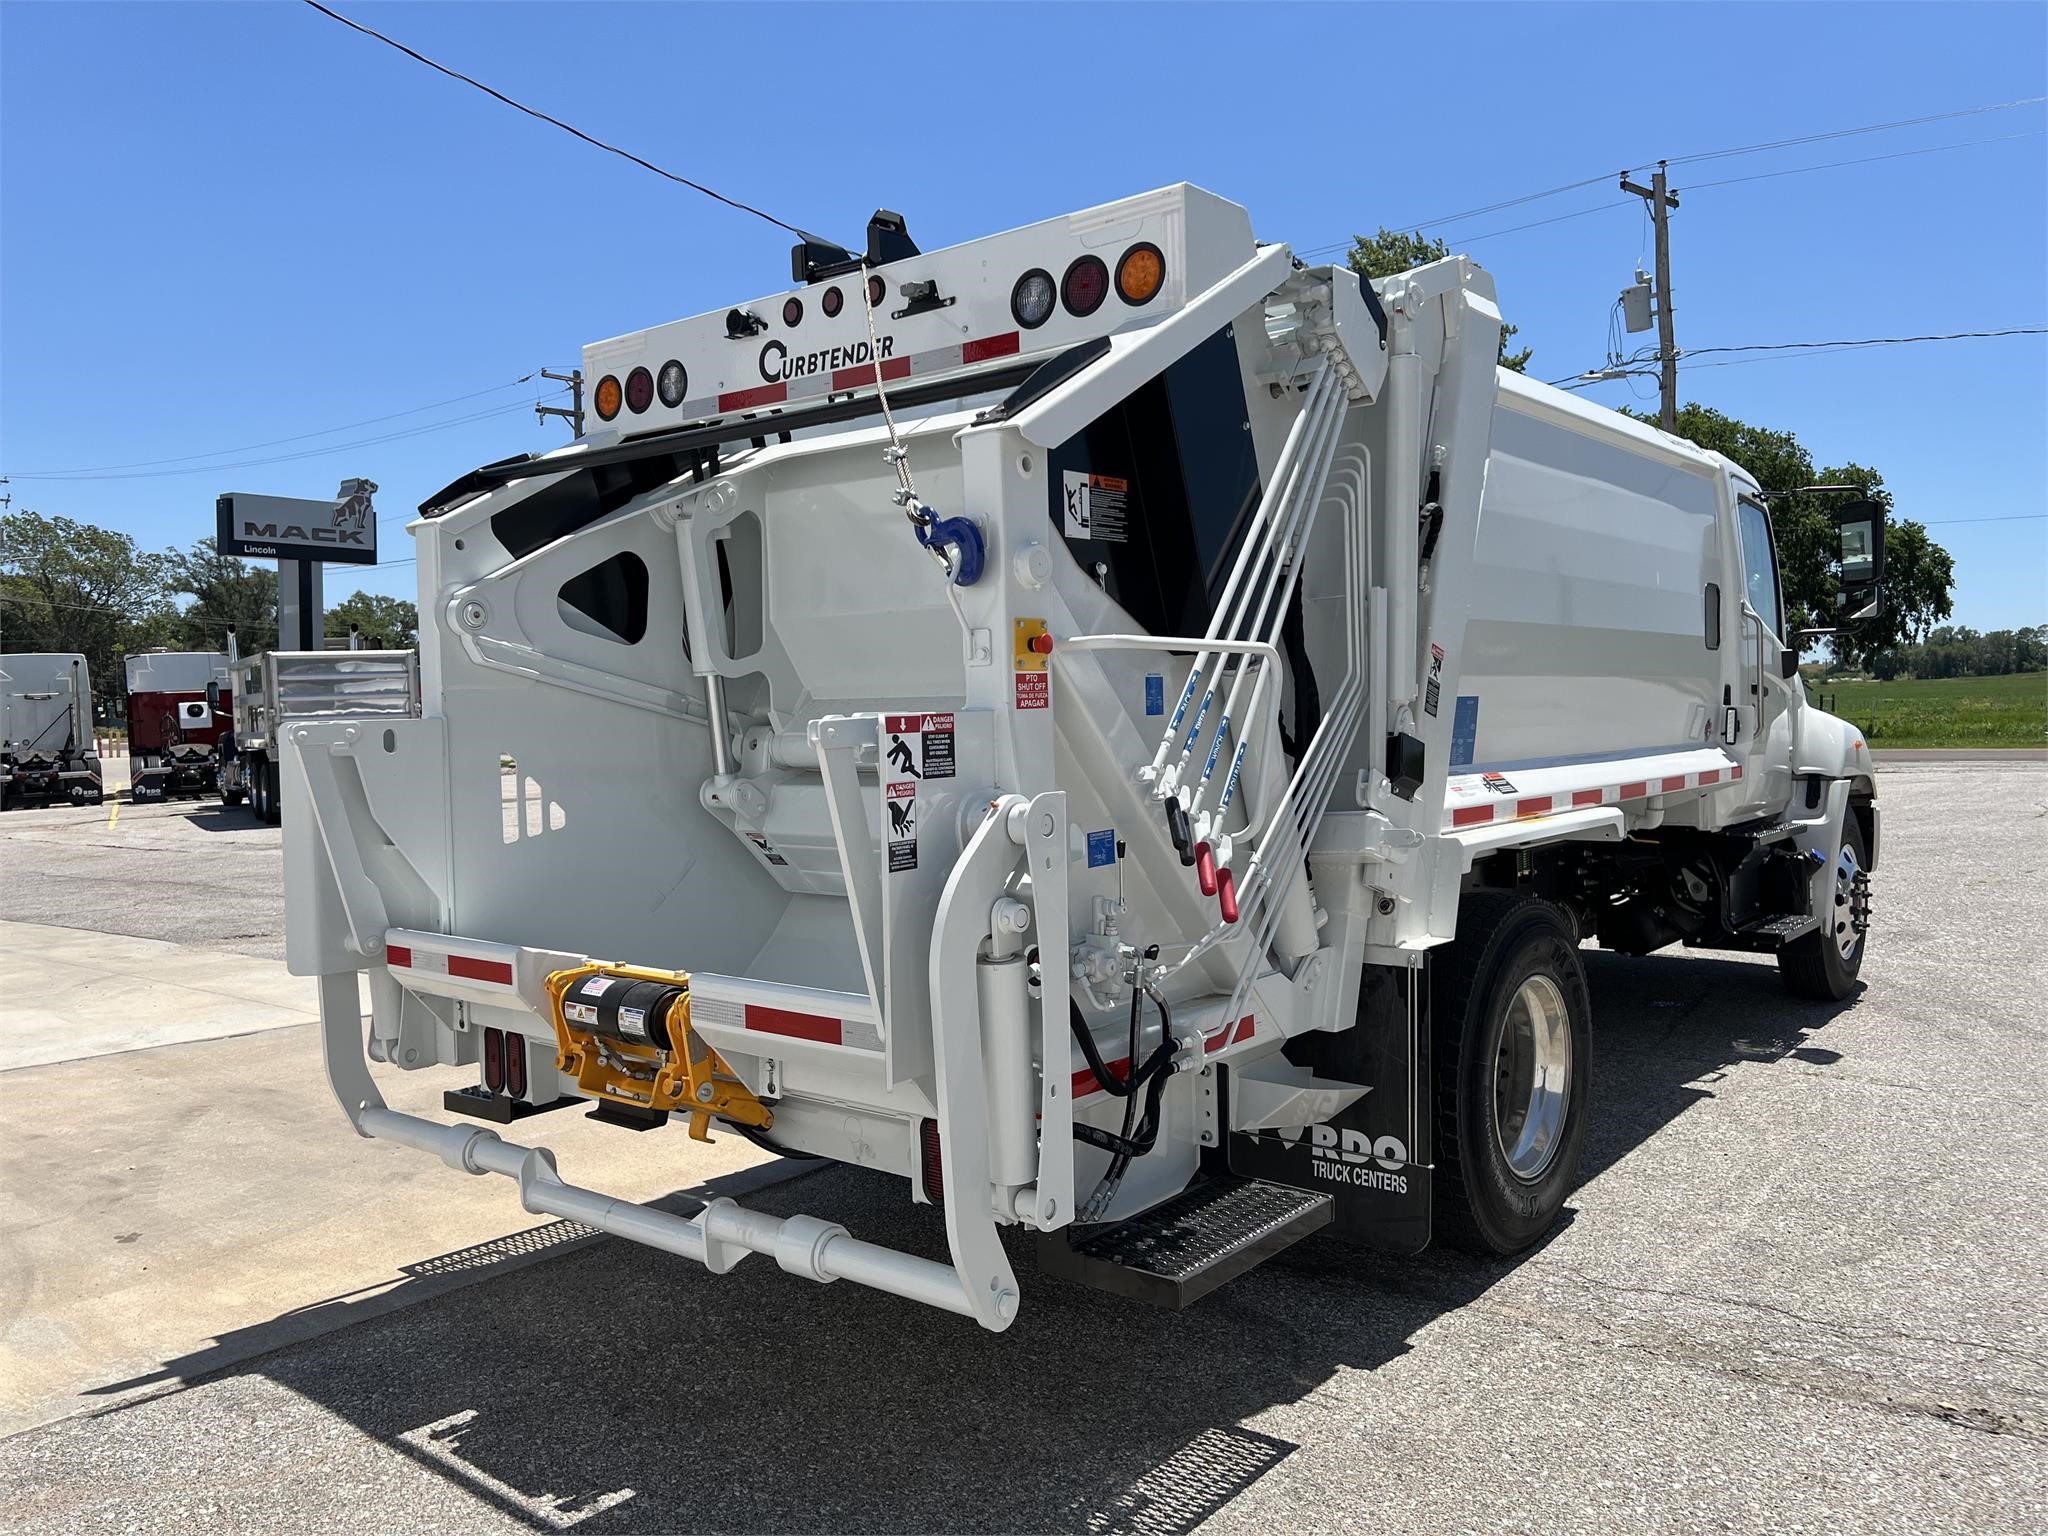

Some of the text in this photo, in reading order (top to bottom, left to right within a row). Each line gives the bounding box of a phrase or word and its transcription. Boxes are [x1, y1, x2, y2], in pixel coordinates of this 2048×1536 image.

[759, 336, 893, 383] CURBTENDER
[244, 522, 365, 545] MACK
[244, 545, 276, 555] Lincoln
[1026, 674, 1038, 682] PTO
[1034, 682, 1046, 690] OFF
[1020, 700, 1045, 708] APAGAR
[1181, 693, 1192, 712] PACK
[1211, 735, 1223, 760] WINCH
[1312, 1123, 1407, 1170] RDO
[1312, 1160, 1407, 1193] TRUCK CENTERS
